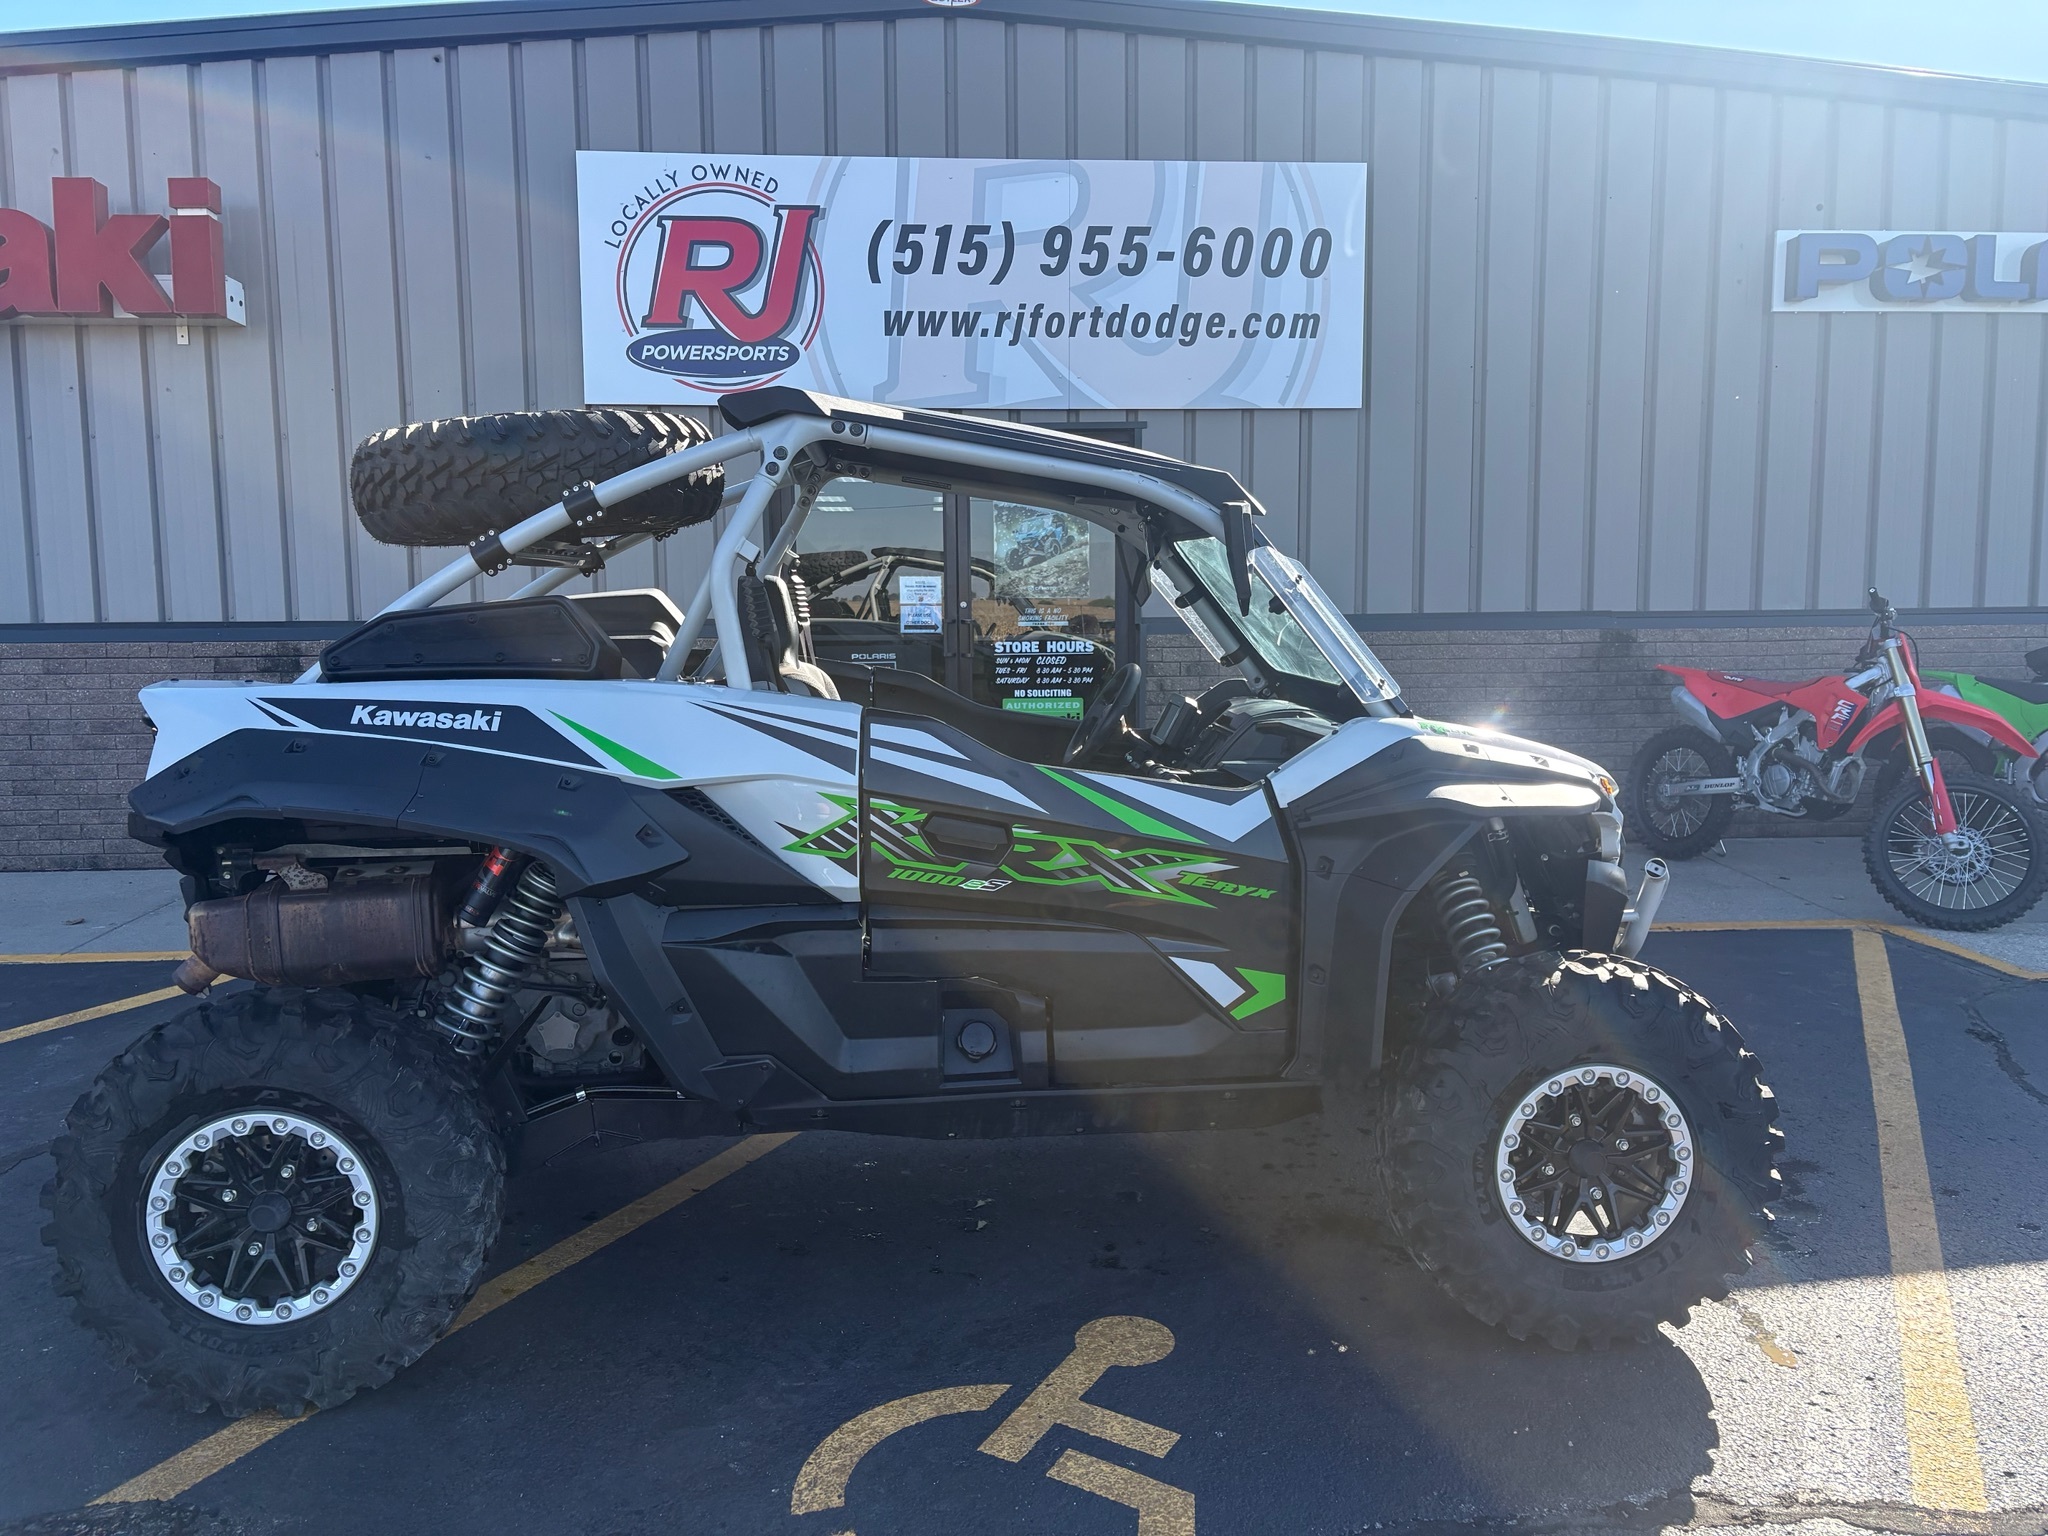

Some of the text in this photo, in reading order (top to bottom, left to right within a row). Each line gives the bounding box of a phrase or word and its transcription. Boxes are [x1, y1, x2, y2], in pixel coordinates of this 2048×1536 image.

[604, 163, 779, 249] LOCALLY OWNED
[867, 219, 1333, 285] (515) 955-6000
[641, 204, 823, 343] RJ
[1783, 233, 2048, 303] POL
[883, 303, 1321, 347] www.rjfortdodge.com
[641, 344, 790, 362] POWERSPORTS
[994, 641, 1095, 653] STORE HOURS
[1036, 656, 1067, 665] CLOSED
[1014, 689, 1072, 697] NO SOLICITING
[1006, 701, 1080, 709] AUTHORIZED
[350, 705, 502, 732] Kawasaki
[1704, 782, 1736, 790] DUNLOP
[887, 868, 966, 887] 1000
